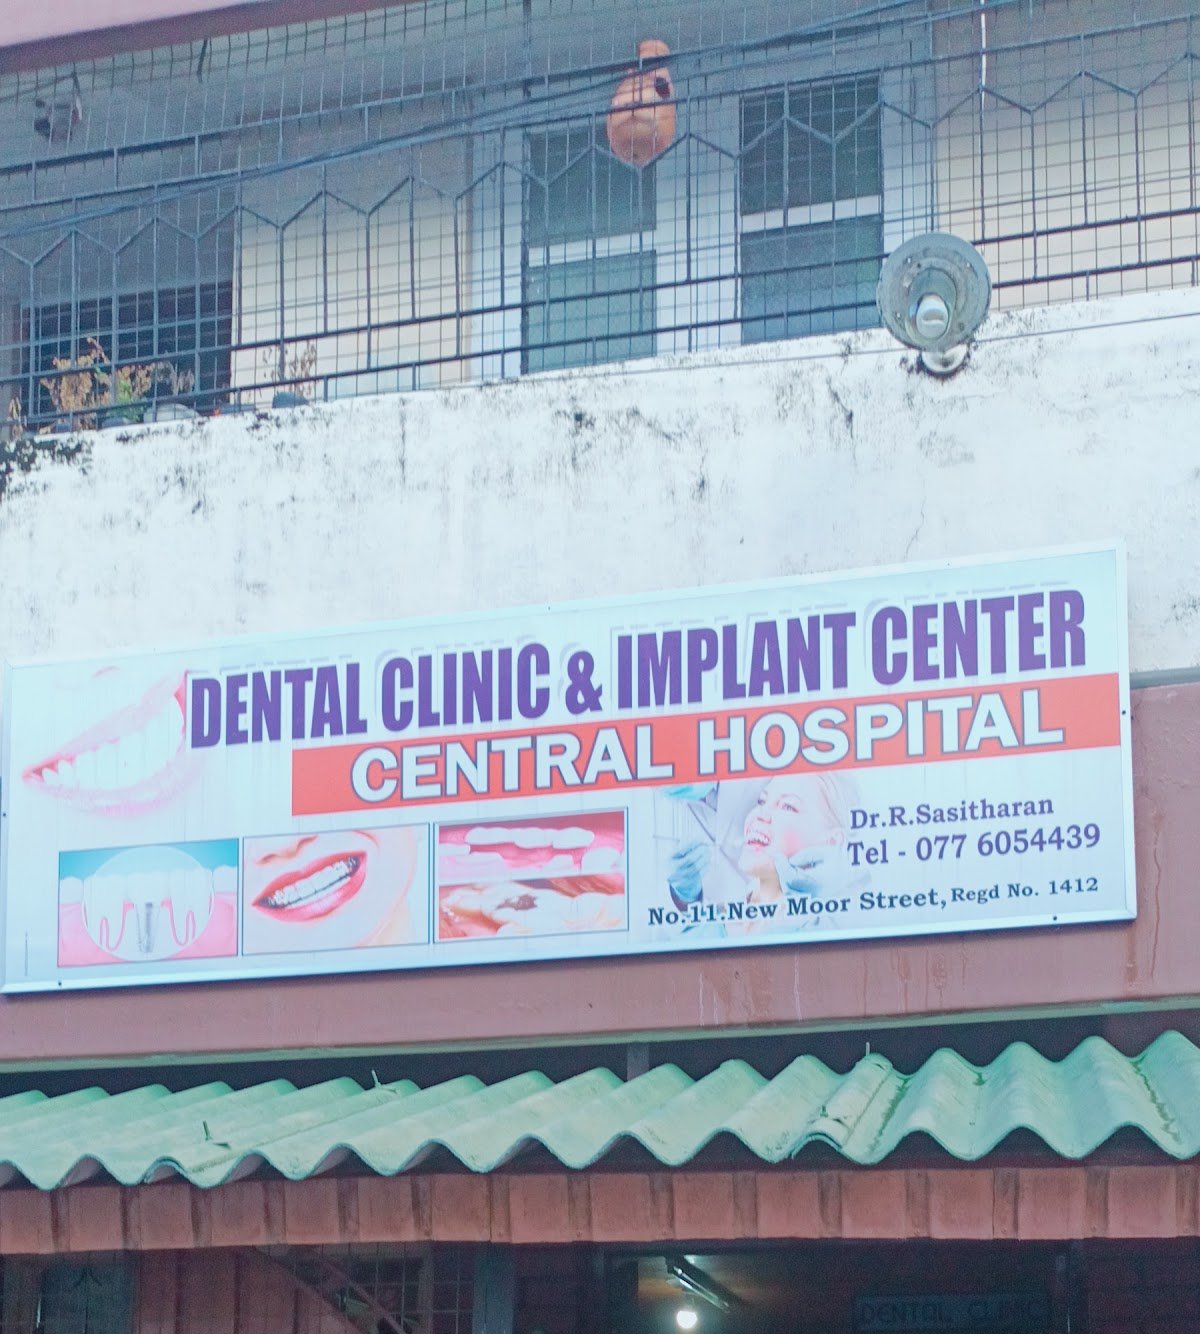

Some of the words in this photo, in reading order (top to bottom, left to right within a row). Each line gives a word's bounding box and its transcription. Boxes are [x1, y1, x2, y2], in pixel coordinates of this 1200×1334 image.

[190, 662, 367, 749] DENTAL
[381, 643, 550, 731] CLINIC
[565, 650, 603, 715] &
[617, 612, 856, 710] IMPLANT
[871, 589, 1086, 686] CENTER
[350, 722, 675, 803] CENTRAL
[698, 688, 1065, 776] HOSPITAL
[850, 798, 1054, 829] Dr.R.Sasitharan
[847, 839, 889, 866] Tel
[916, 834, 967, 861] 077
[977, 823, 1100, 857] 6054439
[786, 896, 851, 917] Moor
[859, 887, 947, 911] Street,
[951, 885, 1000, 904] Regd
[1007, 883, 1039, 898] No.
[1049, 877, 1099, 895] 1412
